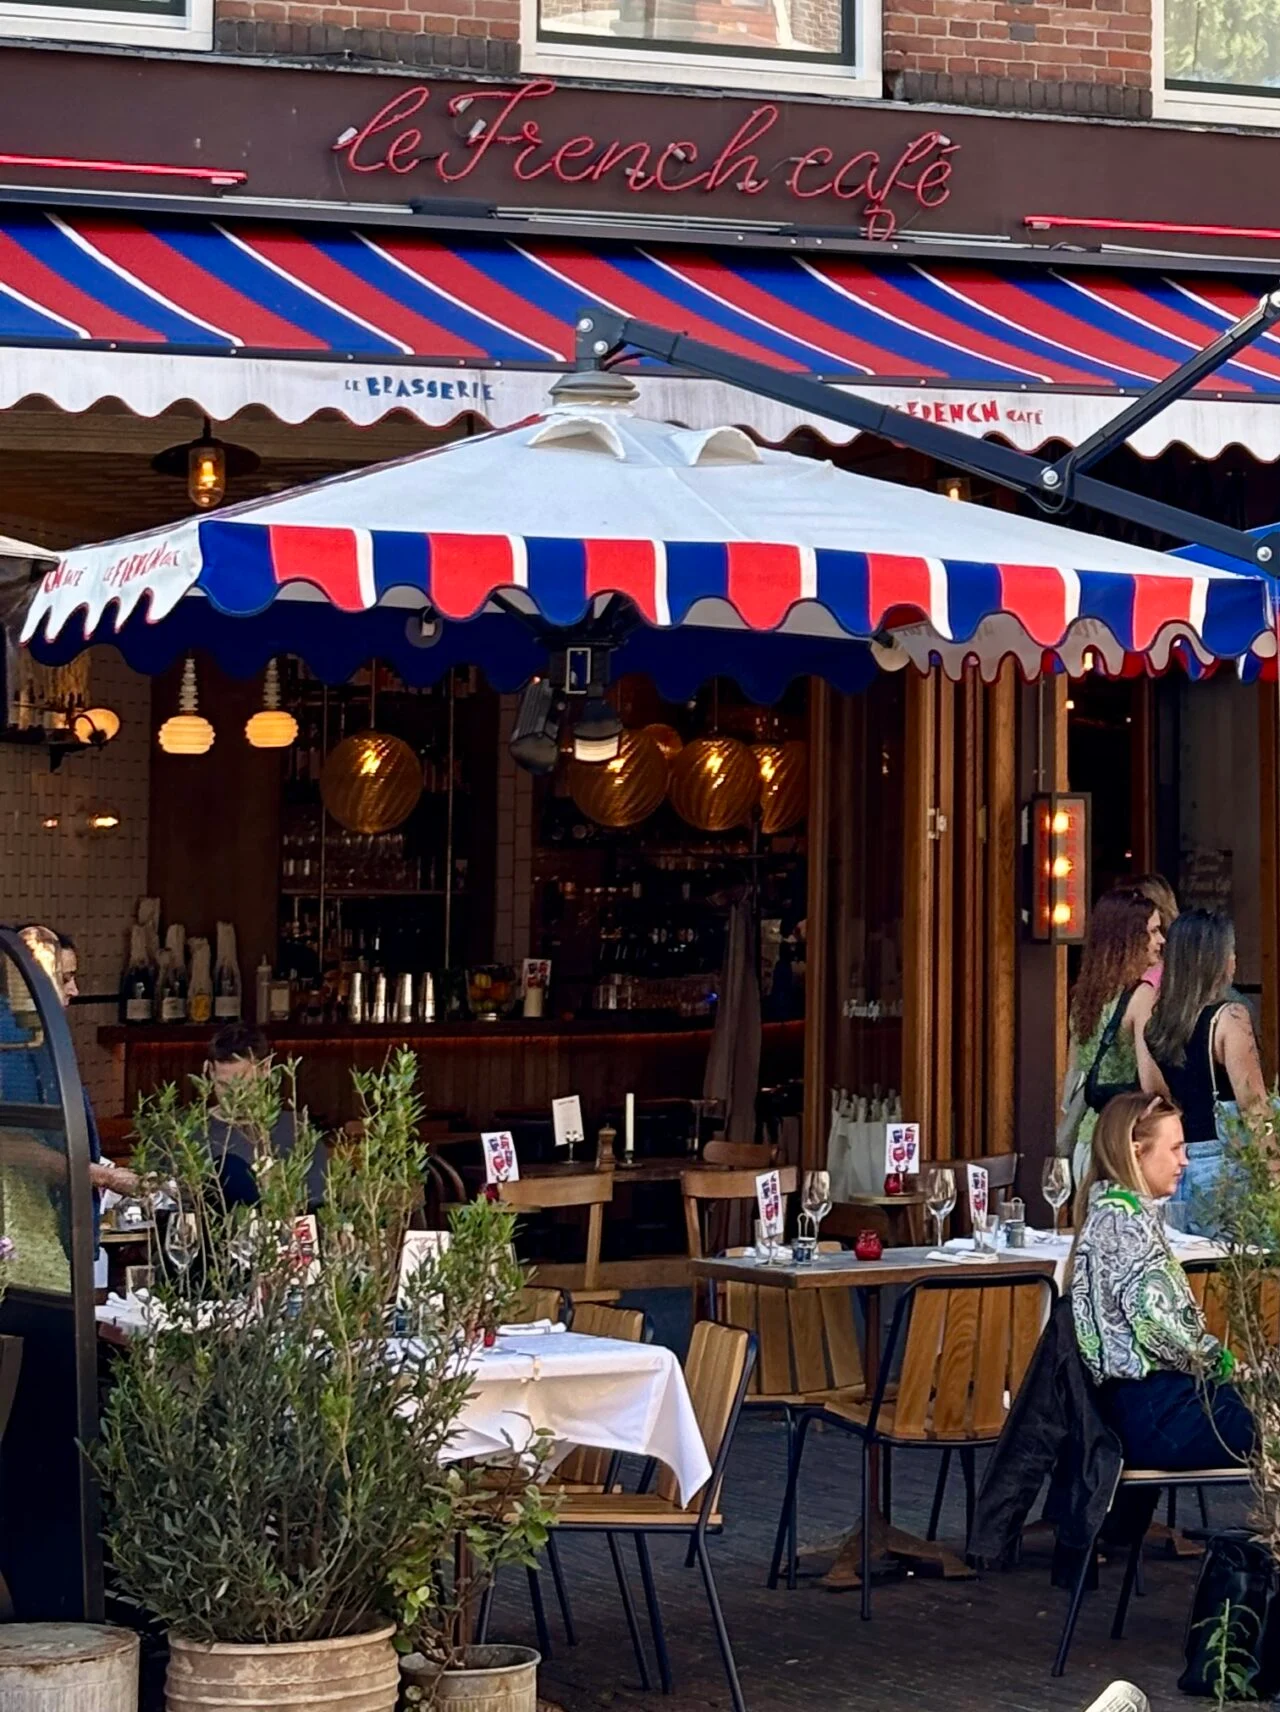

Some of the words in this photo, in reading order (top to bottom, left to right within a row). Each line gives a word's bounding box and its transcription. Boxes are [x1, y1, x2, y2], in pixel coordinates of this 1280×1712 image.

[332, 86, 430, 174] le
[436, 80, 779, 195] French
[790, 131, 962, 241] café
[366, 376, 495, 401] BRASSERIE
